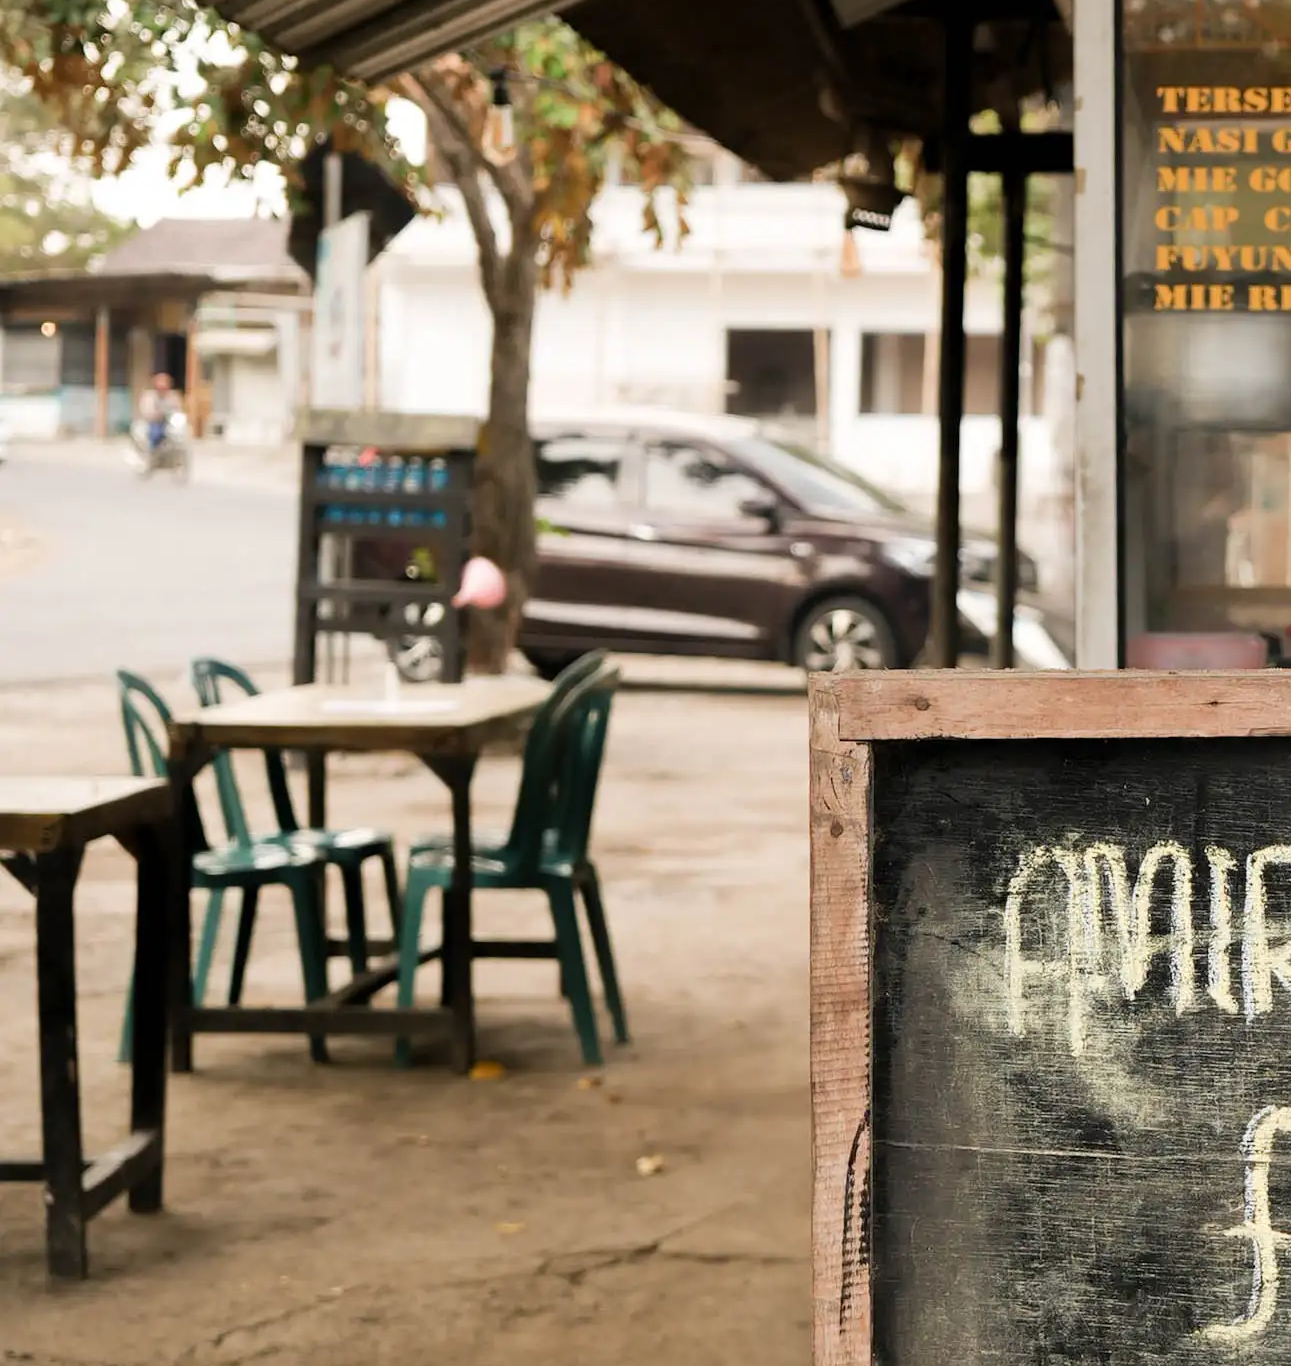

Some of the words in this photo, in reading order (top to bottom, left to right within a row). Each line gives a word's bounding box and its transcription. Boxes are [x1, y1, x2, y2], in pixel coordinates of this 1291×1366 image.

[1158, 127, 1259, 154] NASI
[1156, 166, 1238, 193] MIE
[1155, 205, 1239, 232] CAP
[1153, 284, 1235, 311] MIE
